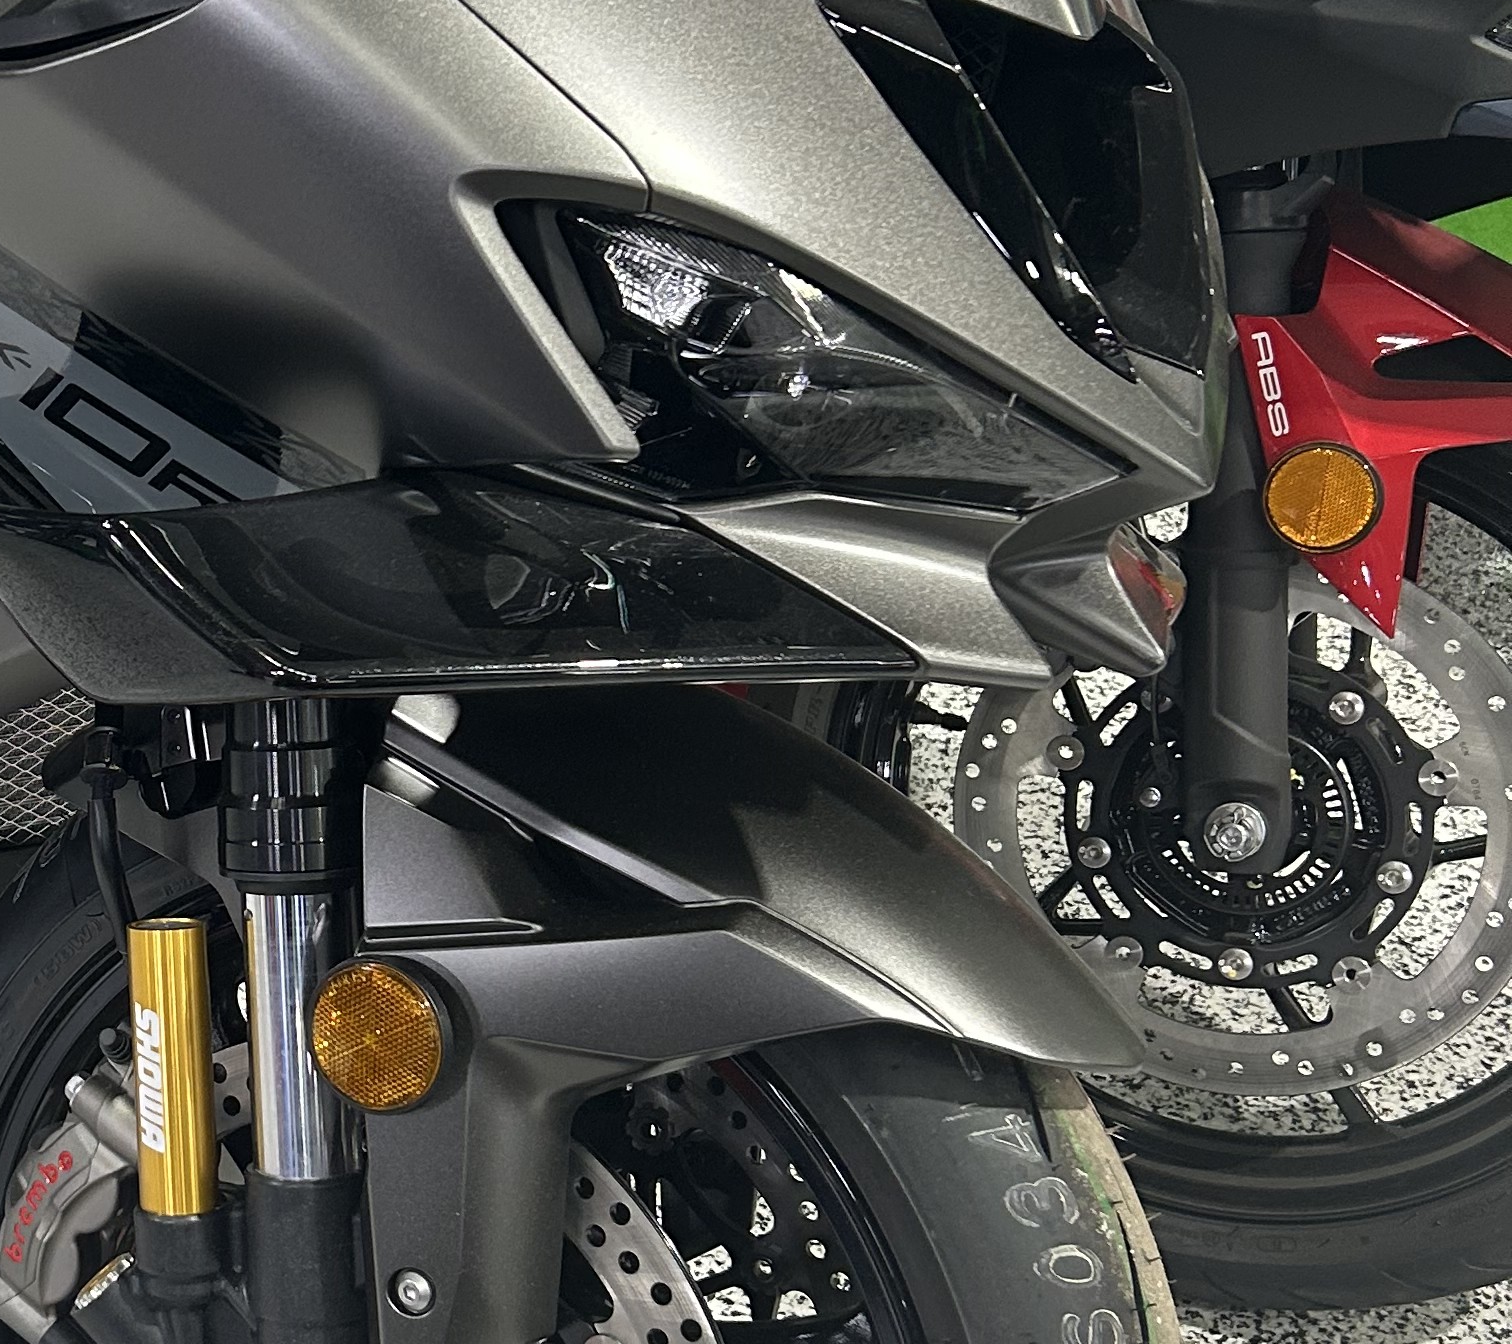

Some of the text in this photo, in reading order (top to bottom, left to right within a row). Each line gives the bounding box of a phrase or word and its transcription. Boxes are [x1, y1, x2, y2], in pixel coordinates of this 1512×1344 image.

[1251, 331, 1290, 437] ABS
[134, 1001, 166, 1154] SHOWA
[3, 1150, 74, 1264] brembo
